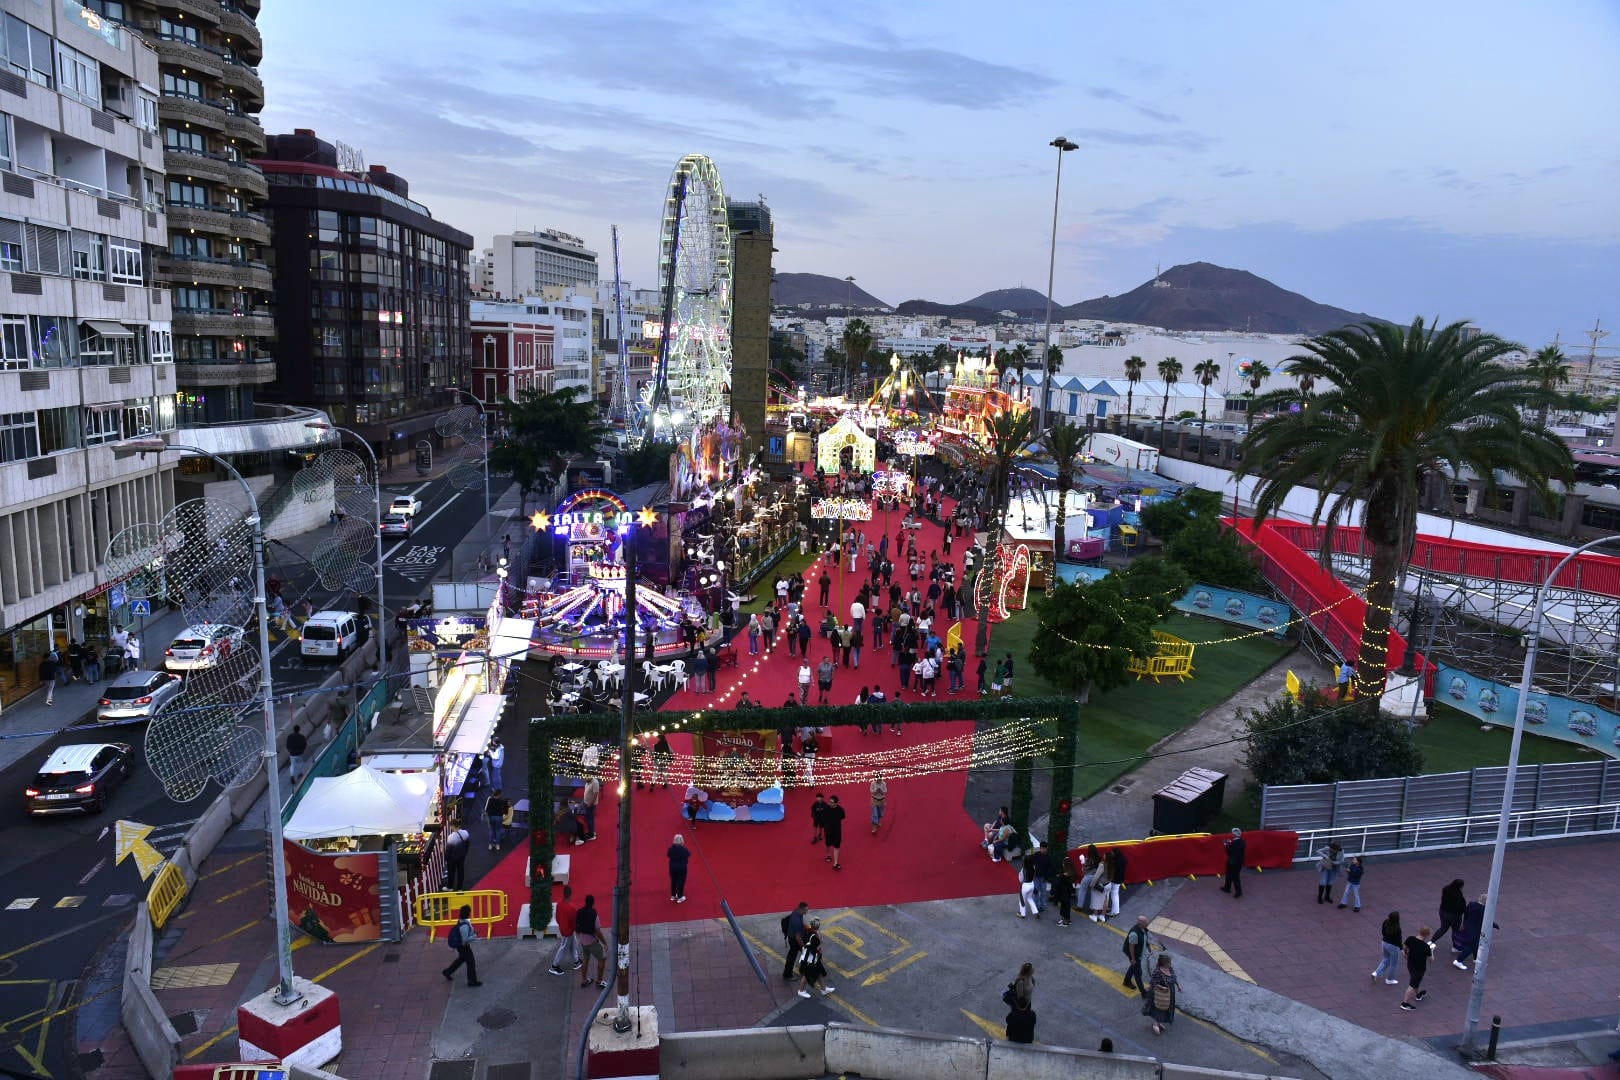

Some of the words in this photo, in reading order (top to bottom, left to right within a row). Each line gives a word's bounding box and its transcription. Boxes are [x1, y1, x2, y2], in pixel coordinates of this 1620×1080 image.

[554, 512, 604, 526] SALTA
[615, 511, 633, 525] IN
[409, 545, 447, 553] TAXI
[393, 556, 437, 564] SOLO
[716, 737, 753, 747] NAVIDAD
[293, 878, 342, 907] NAVIDAD
